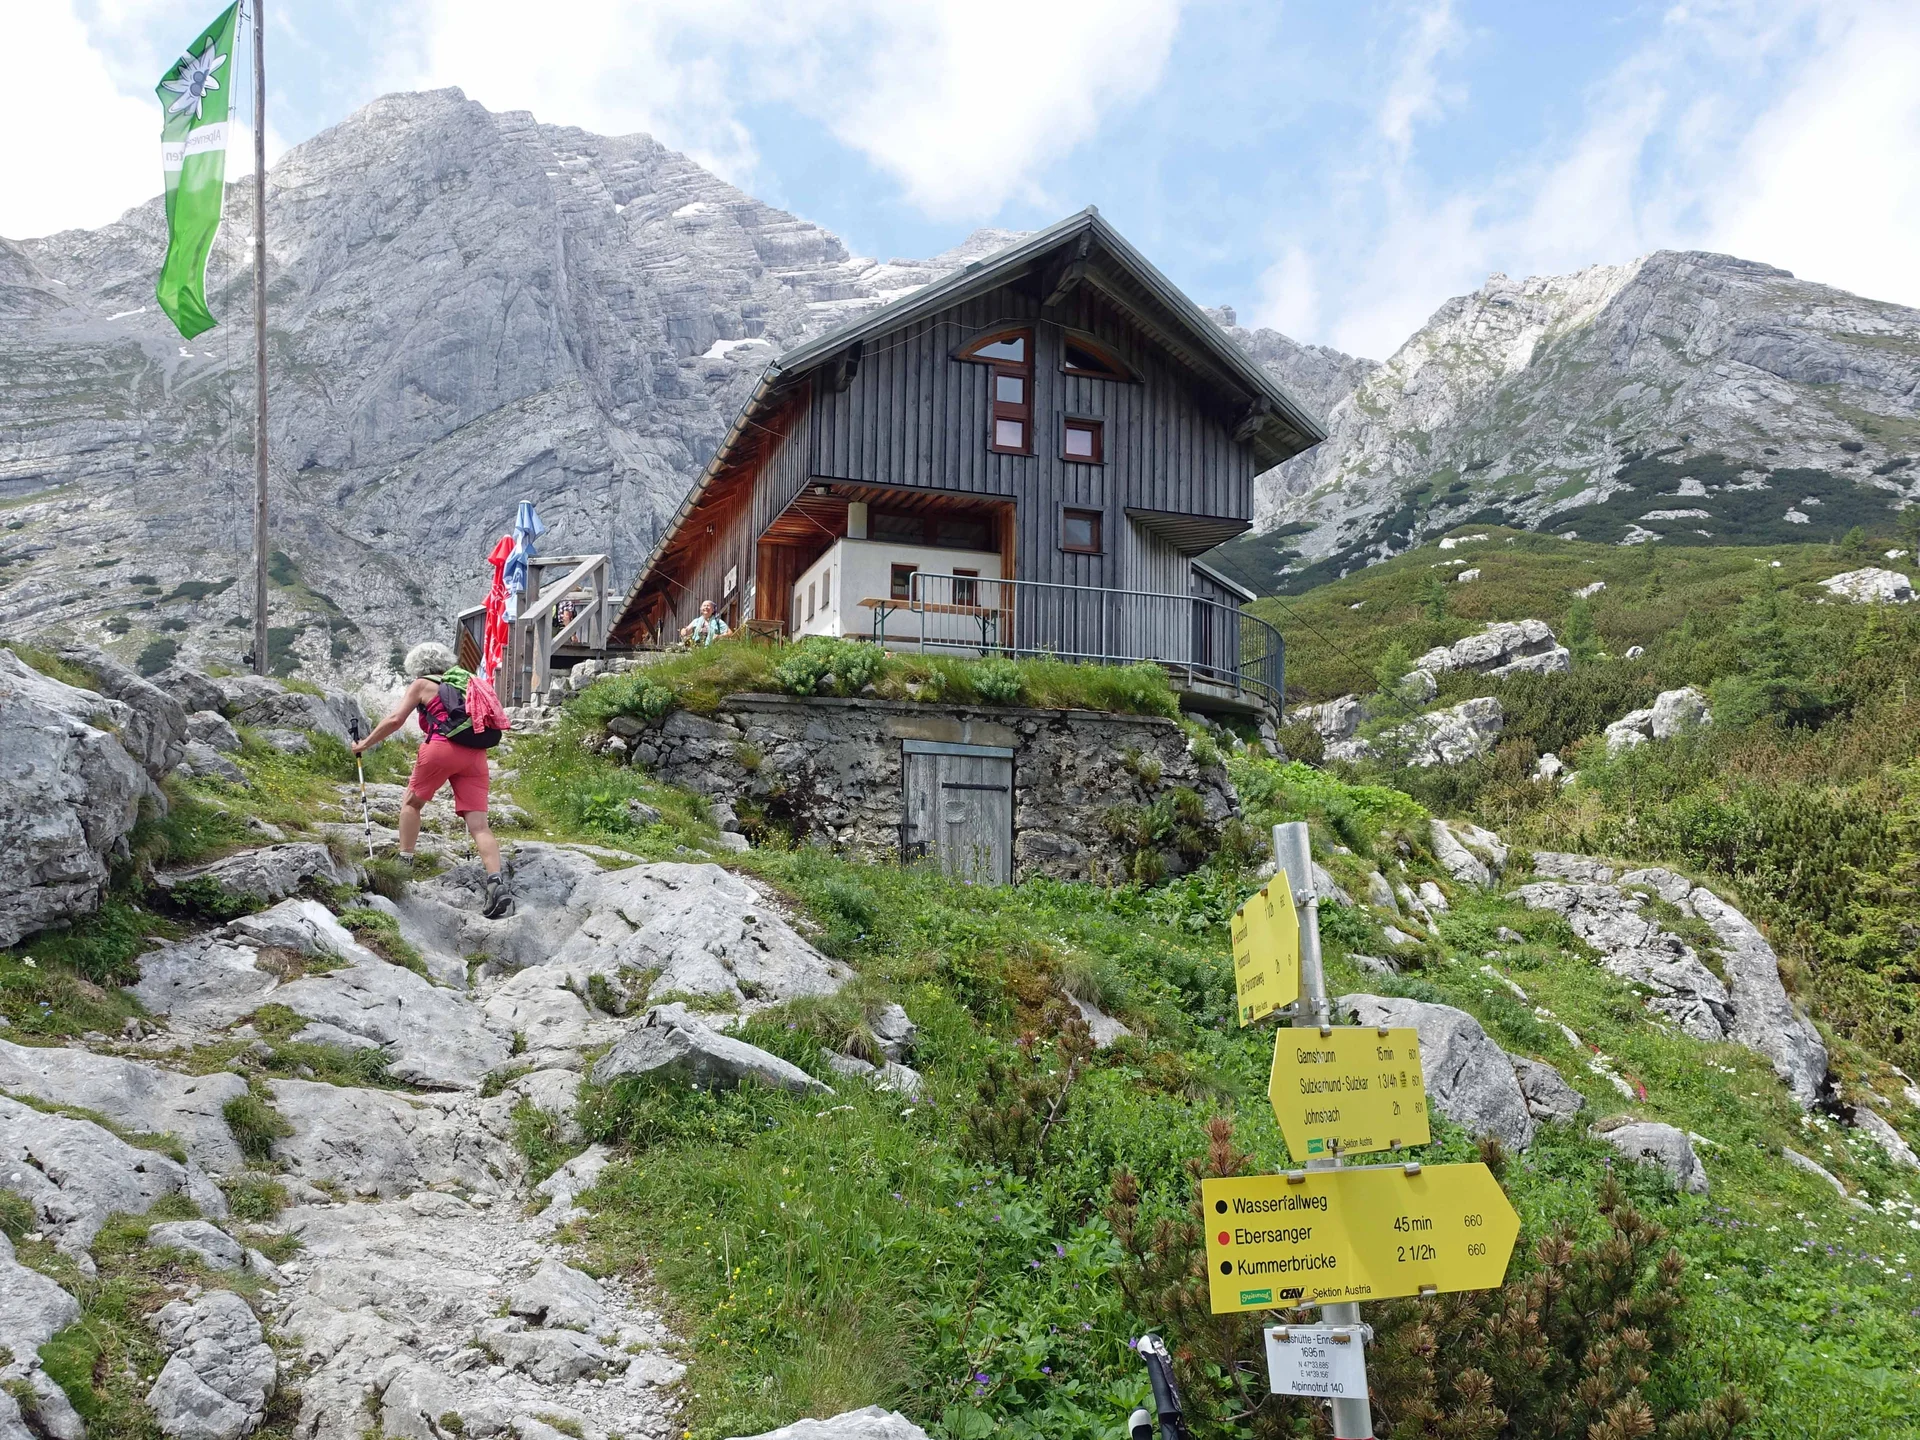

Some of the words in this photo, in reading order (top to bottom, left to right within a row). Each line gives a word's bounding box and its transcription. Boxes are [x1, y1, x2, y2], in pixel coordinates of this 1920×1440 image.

[1296, 1047, 1336, 1064] Gamsbrunn
[1376, 1046, 1383, 1061] 15
[1384, 1046, 1395, 1061] min
[1304, 1106, 1341, 1125] Johnsbach
[1392, 1100, 1401, 1116] 2h
[1232, 1194, 1328, 1214] Wasserfallweg
[1235, 1226, 1312, 1245] Ebersanger
[1393, 1216, 1410, 1232] 45
[1411, 1215, 1433, 1231] min
[1464, 1213, 1483, 1227] 660
[1237, 1252, 1337, 1276] Kummerbrücke
[1397, 1246, 1406, 1262] 2
[1409, 1244, 1436, 1261] 1/2h
[1467, 1242, 1486, 1257] 660
[1312, 1286, 1342, 1299] Sektion
[1344, 1284, 1372, 1296] Austria
[1301, 1347, 1318, 1358] 1695
[1319, 1349, 1326, 1358] m
[1300, 1369, 1305, 1378] E
[1291, 1380, 1328, 1394] Alpinnotruf
[1330, 1382, 1344, 1394] 140
